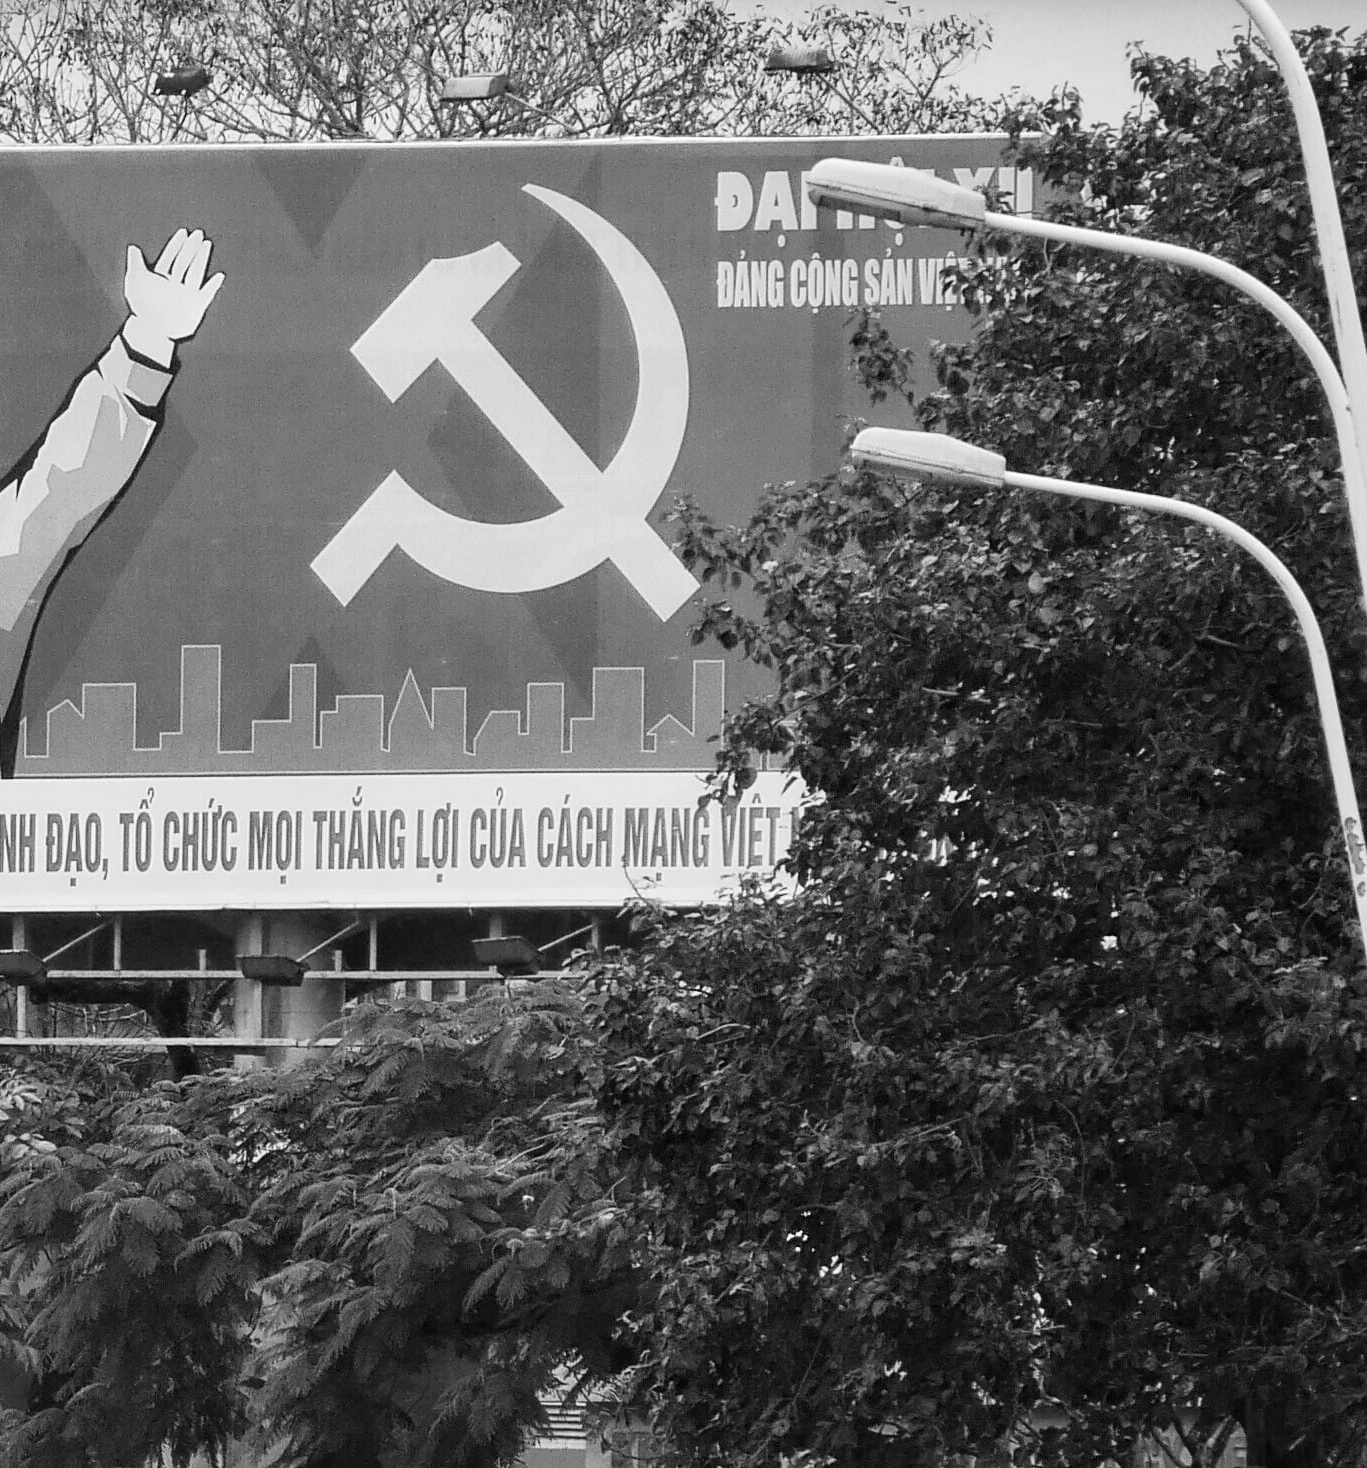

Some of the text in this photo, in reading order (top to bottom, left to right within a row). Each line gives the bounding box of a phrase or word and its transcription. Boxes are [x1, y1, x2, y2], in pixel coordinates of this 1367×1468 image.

[717, 249, 784, 308] ĐẢNG
[790, 252, 858, 313] CỘNG
[864, 248, 913, 307] SẢN
[46, 812, 109, 887] ĐẠO,
[119, 787, 154, 873] TỔ
[163, 797, 238, 872] CHỨC
[248, 810, 303, 885] MỌI
[313, 786, 407, 871] THẮNG
[416, 802, 459, 884] LỢI
[469, 786, 527, 870] CỦA
[537, 794, 614, 869] CÁCH
[623, 806, 710, 882] MẠNG
